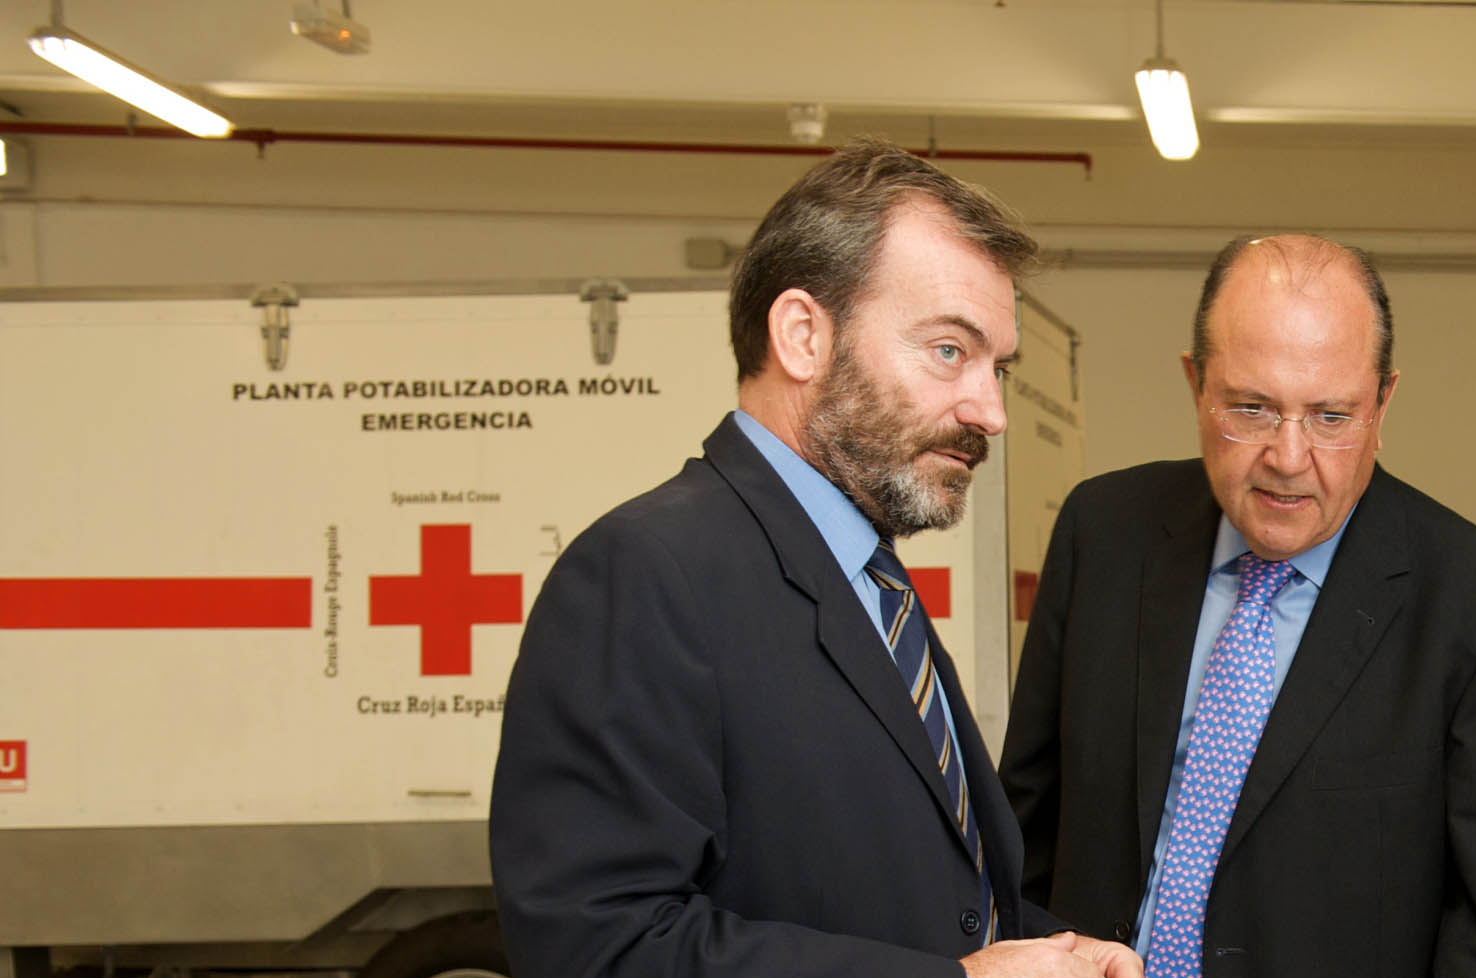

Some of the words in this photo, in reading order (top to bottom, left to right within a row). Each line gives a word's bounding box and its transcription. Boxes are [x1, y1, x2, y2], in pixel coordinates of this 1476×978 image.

[232, 382, 334, 401] PLANTA
[343, 378, 570, 399] POTABILIZADORA
[579, 373, 661, 396] MÓVIL
[361, 411, 533, 432] EMERGENCIA
[391, 490, 437, 507] Spanish
[441, 490, 463, 503] Red
[467, 490, 501, 503] Cross
[356, 696, 401, 714] Cruz
[406, 696, 448, 718] Roja
